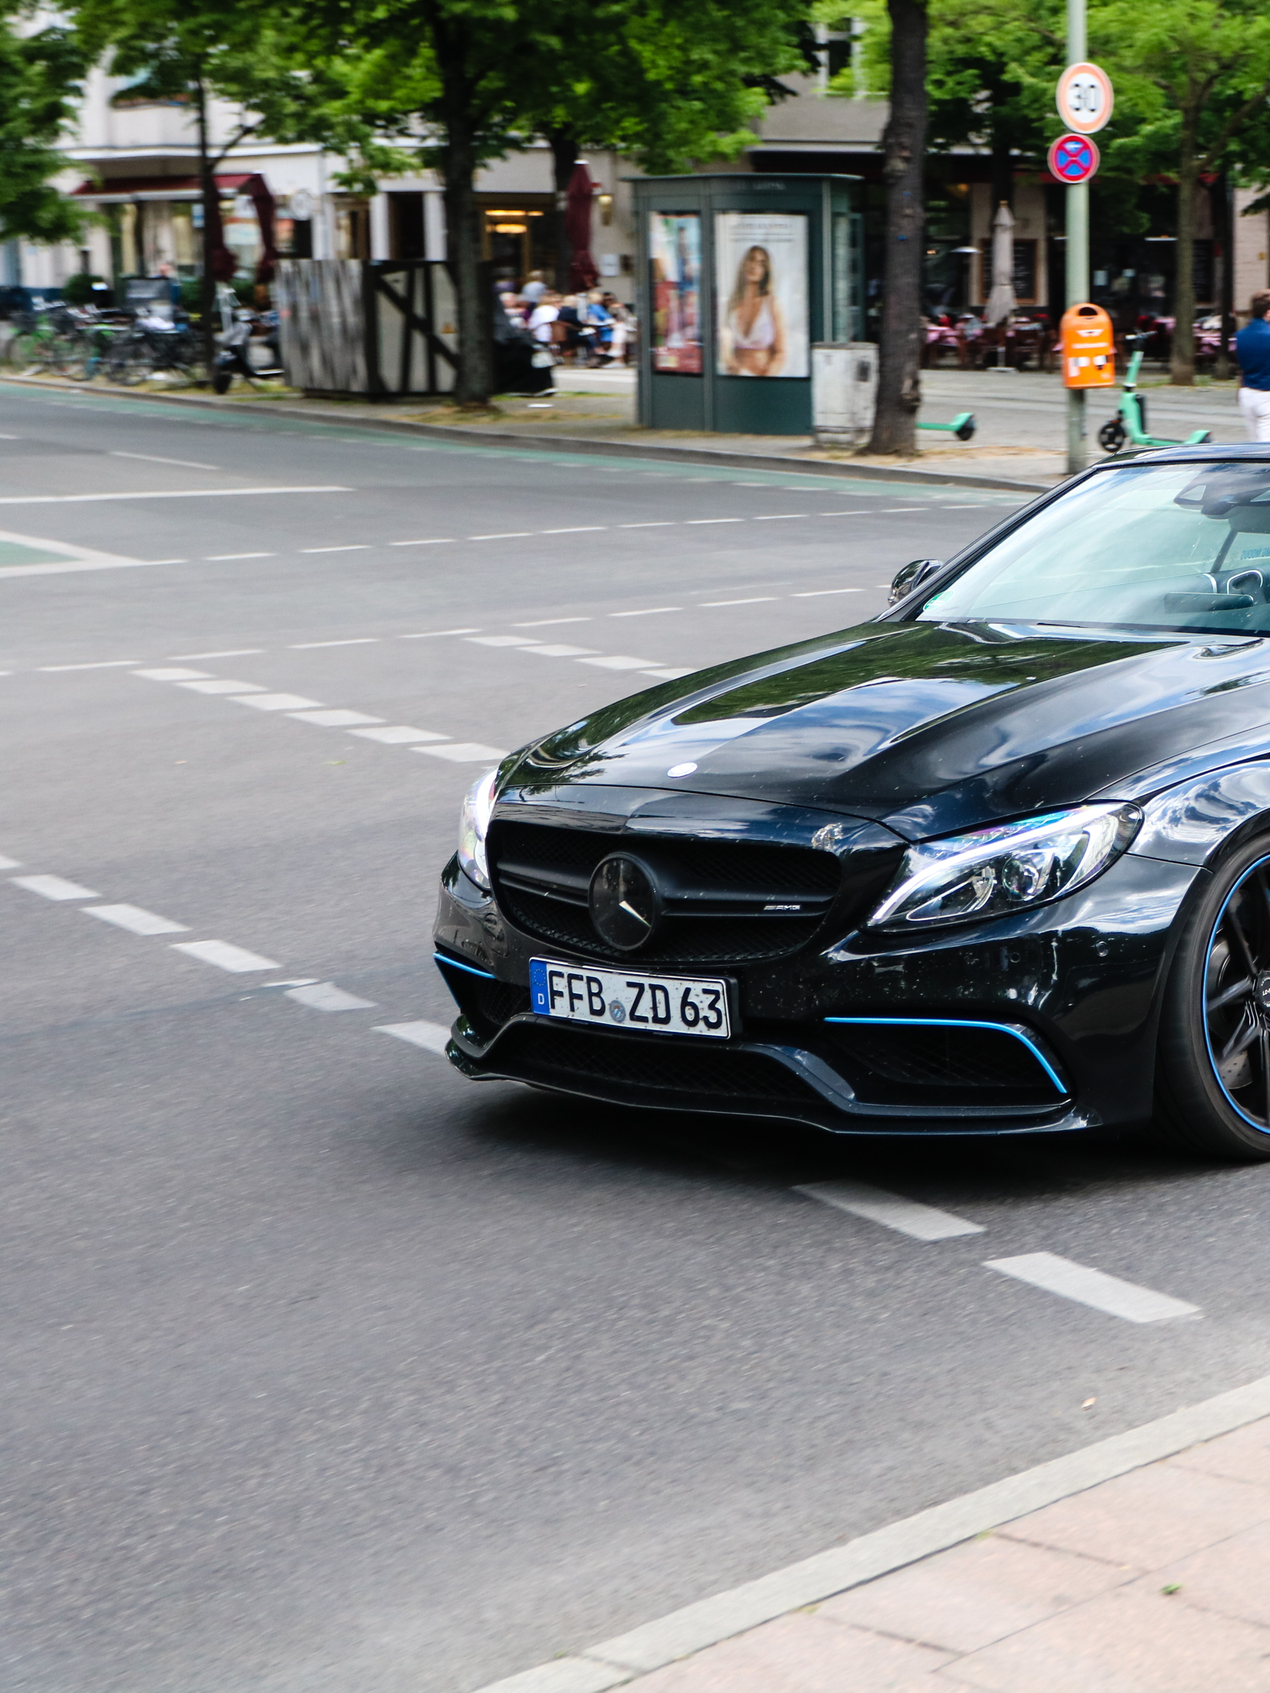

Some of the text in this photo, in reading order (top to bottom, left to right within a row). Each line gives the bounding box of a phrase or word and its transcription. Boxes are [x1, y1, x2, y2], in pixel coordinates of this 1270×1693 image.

[1069, 83, 1101, 112] 30
[537, 970, 723, 1030] D FFB ZD 63
